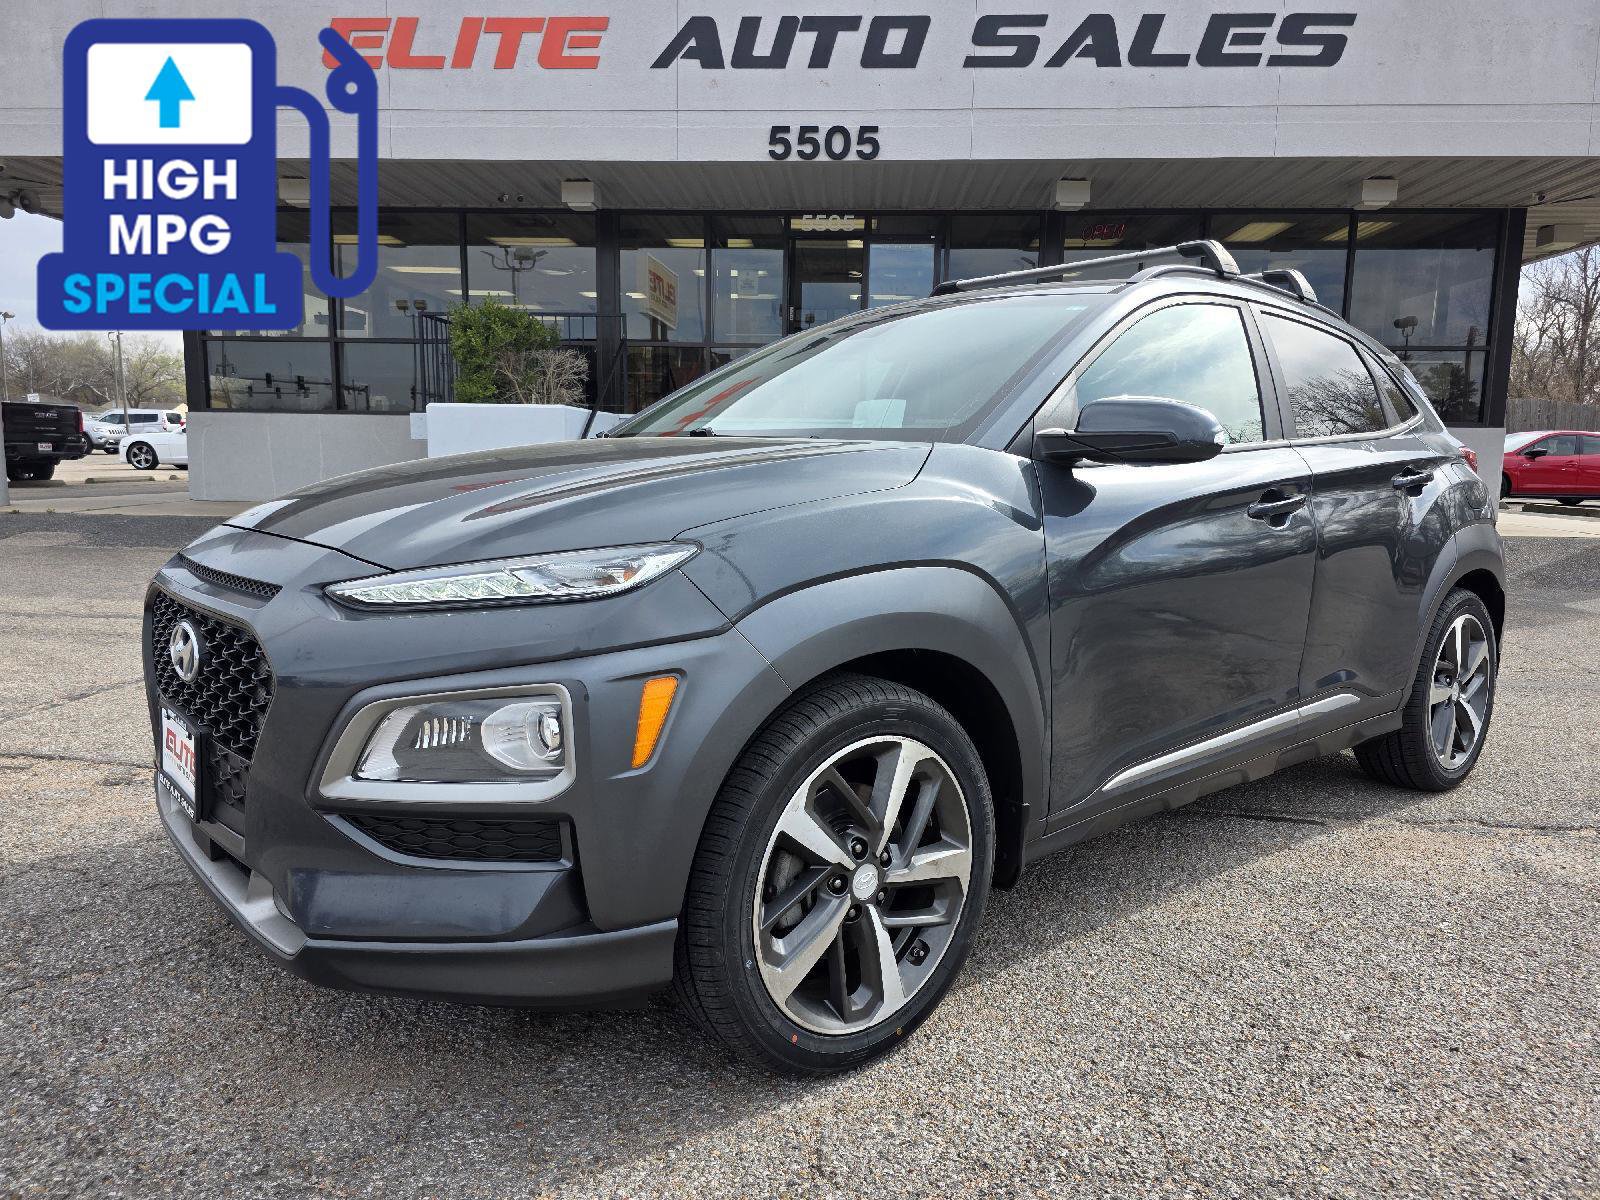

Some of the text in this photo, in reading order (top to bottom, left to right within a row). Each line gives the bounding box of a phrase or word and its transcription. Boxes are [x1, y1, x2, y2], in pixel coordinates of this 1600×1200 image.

[322, 13, 1357, 70] ELITE AUTO SALES
[768, 125, 880, 161] 5505
[801, 214, 855, 232] 5505
[1082, 223, 1127, 241] OPEN
[165, 727, 196, 777] ELITE
